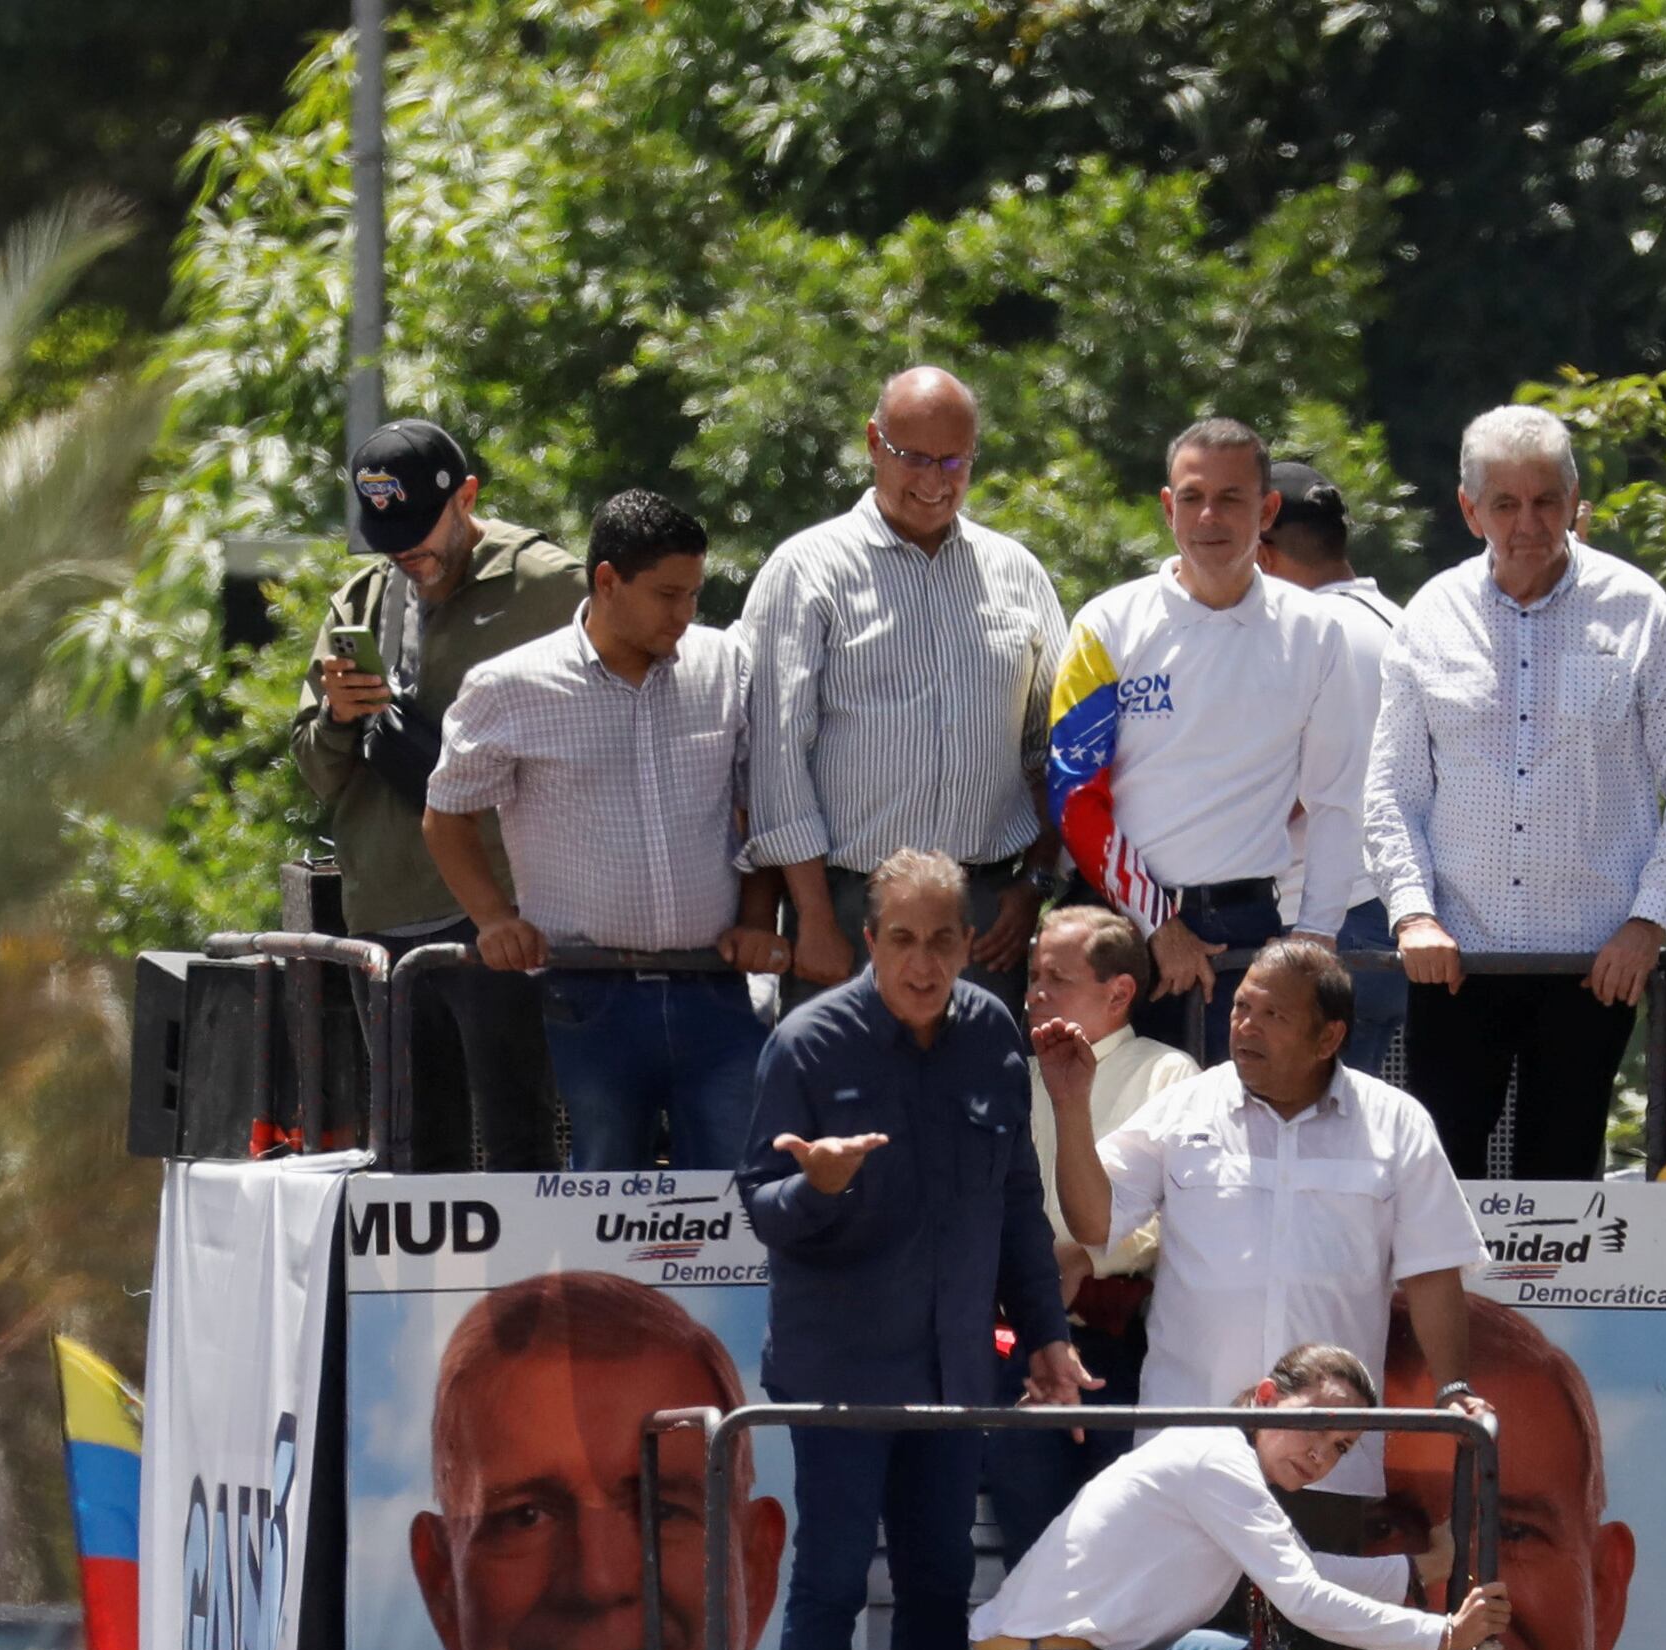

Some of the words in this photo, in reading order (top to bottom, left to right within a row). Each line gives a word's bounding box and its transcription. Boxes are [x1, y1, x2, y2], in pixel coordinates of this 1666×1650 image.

[1119, 674, 1171, 698] CON
[536, 1173, 610, 1198] Mesa
[621, 1173, 654, 1197] de
[655, 1171, 676, 1196] la
[1480, 1192, 1511, 1216] de
[1514, 1192, 1536, 1217] la
[349, 1200, 501, 1257] MUD
[596, 1210, 733, 1243] Unidad
[1482, 1231, 1592, 1264] nidad
[661, 1261, 770, 1283] Democrá
